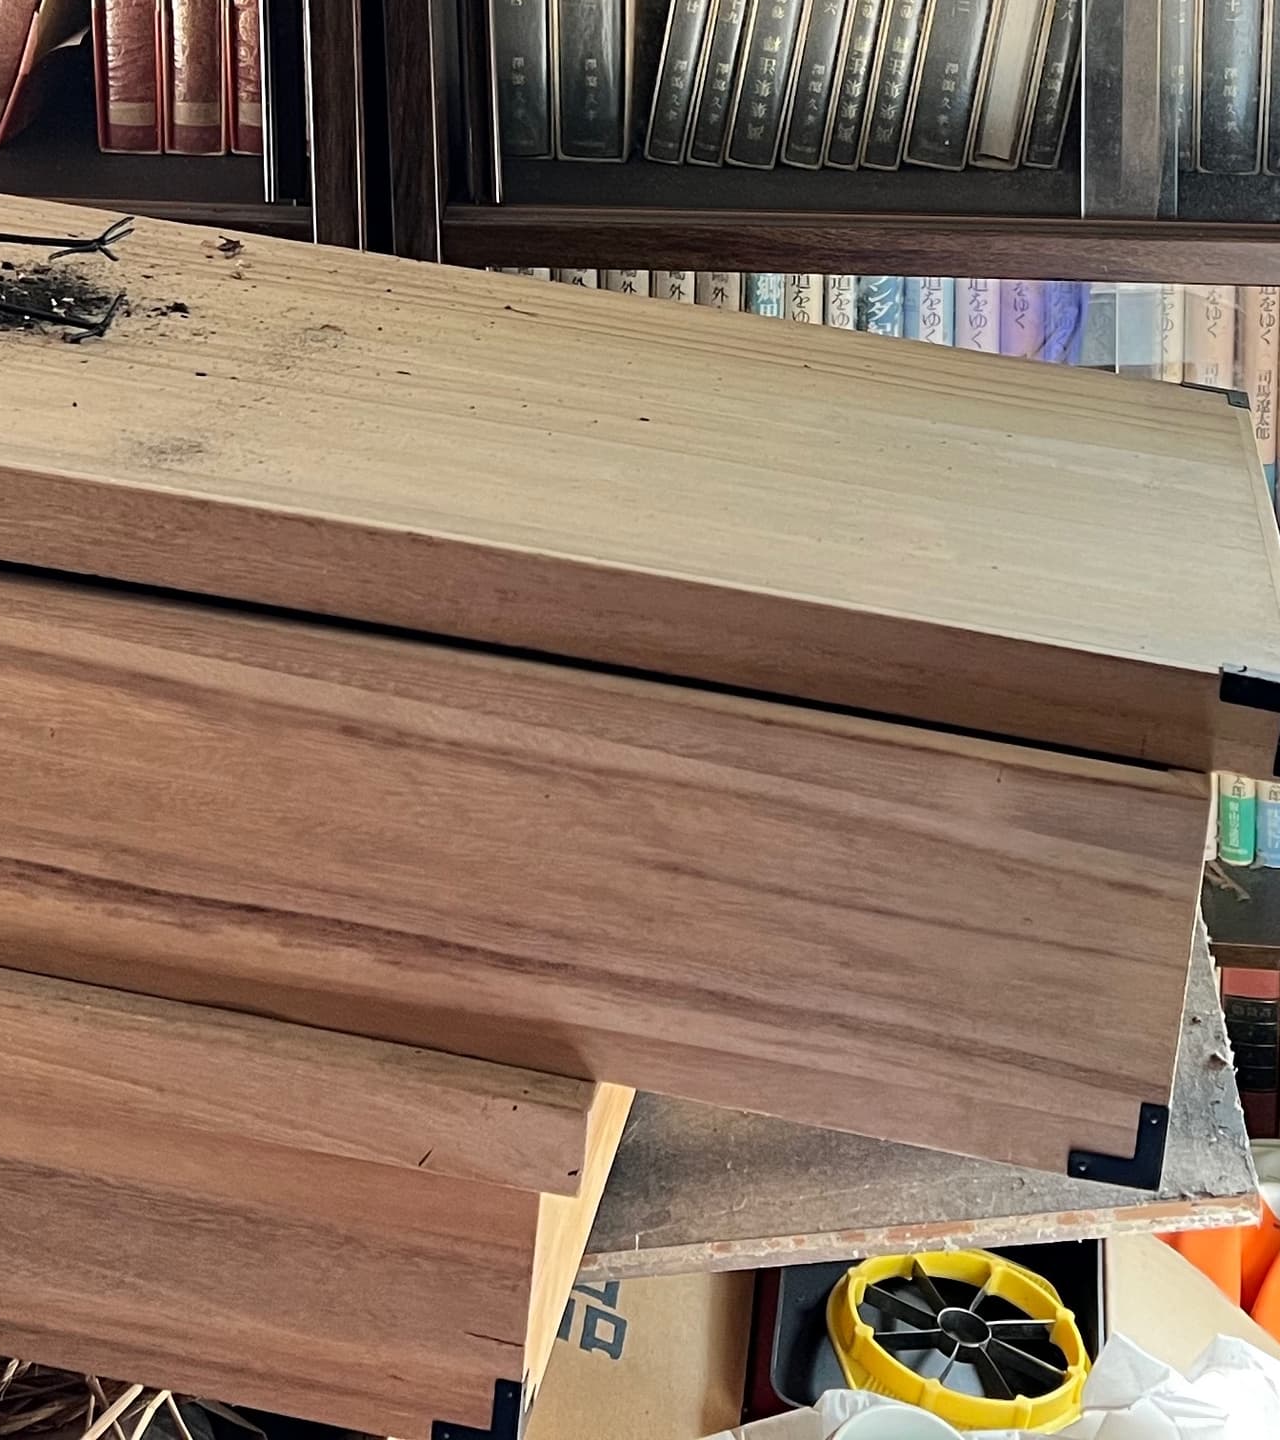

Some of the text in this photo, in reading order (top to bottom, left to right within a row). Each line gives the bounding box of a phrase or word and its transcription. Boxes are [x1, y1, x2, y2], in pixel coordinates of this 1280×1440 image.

[1256, 370, 1272, 441] 司馬遼太郎
